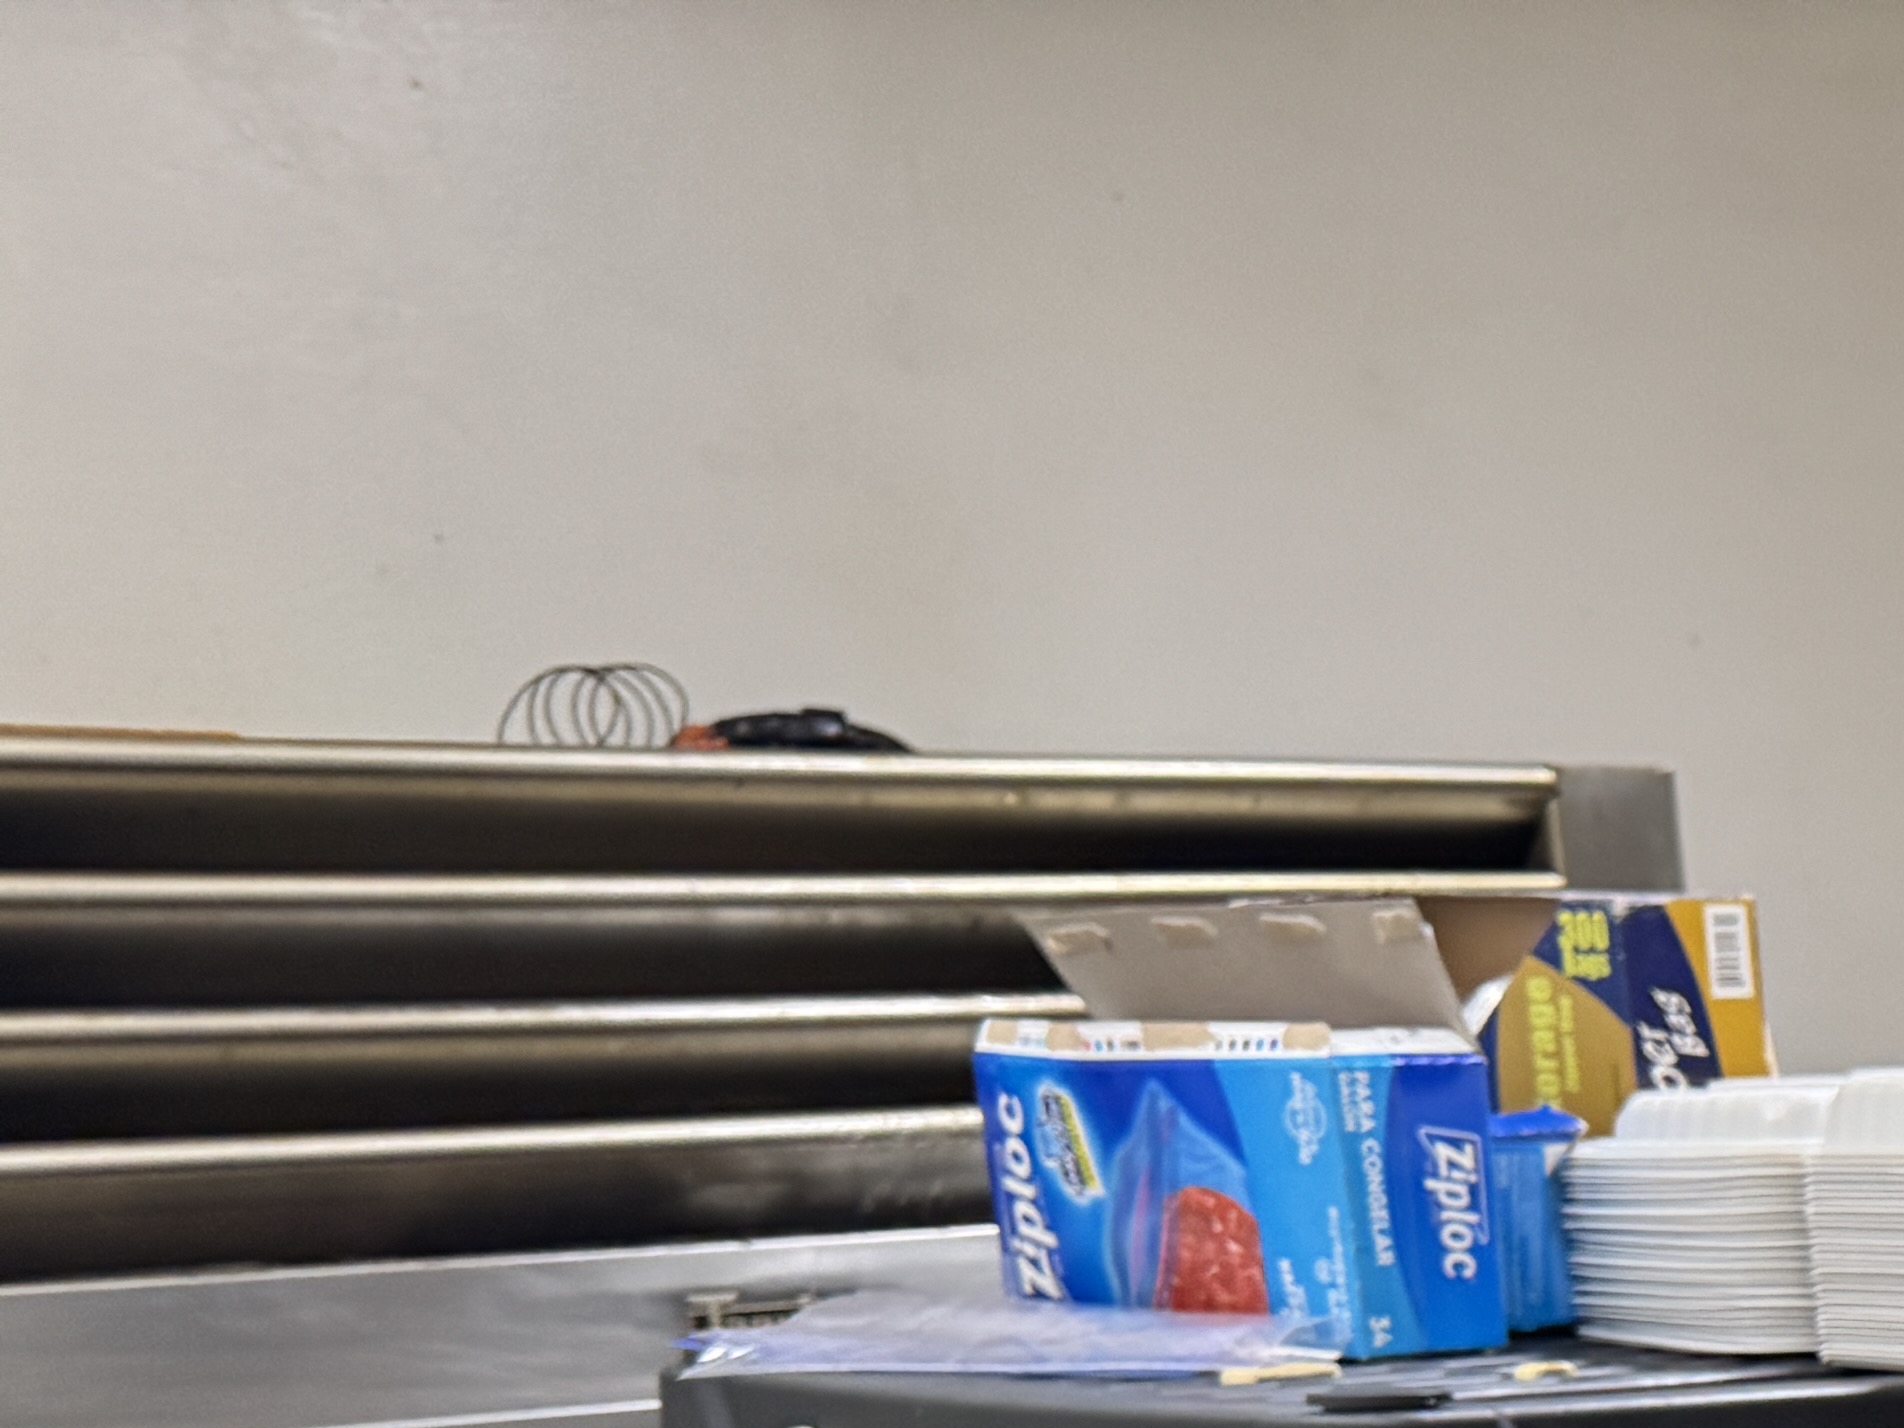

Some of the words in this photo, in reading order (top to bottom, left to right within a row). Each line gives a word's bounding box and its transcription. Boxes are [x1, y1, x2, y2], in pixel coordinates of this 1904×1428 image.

[1353, 1071, 1375, 1132] PARA
[997, 1093, 1065, 1301] Ziploc
[1424, 1142, 1477, 1280] Ziploc
